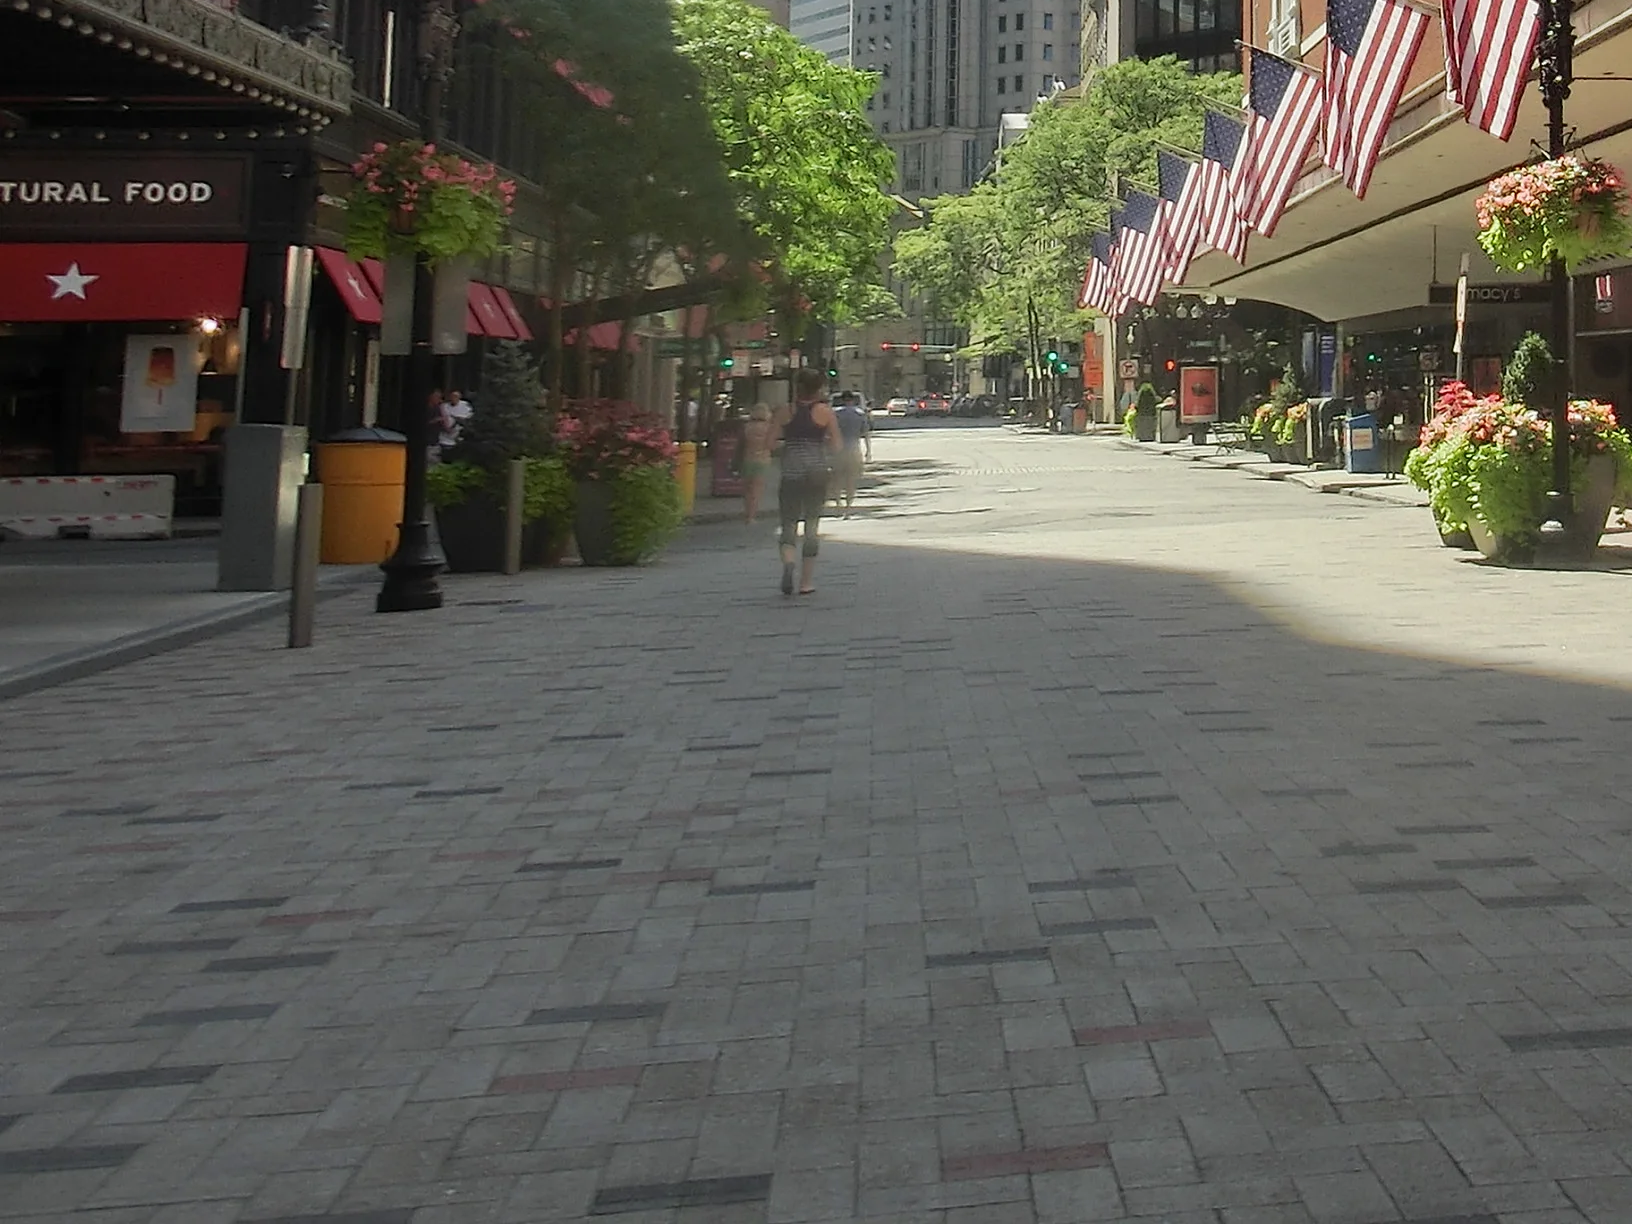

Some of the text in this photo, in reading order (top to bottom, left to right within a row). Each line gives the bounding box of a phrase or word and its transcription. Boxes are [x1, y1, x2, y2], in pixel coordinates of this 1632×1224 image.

[0, 182, 212, 202] TURAL FOOD
[1467, 287, 1520, 301] macy's
